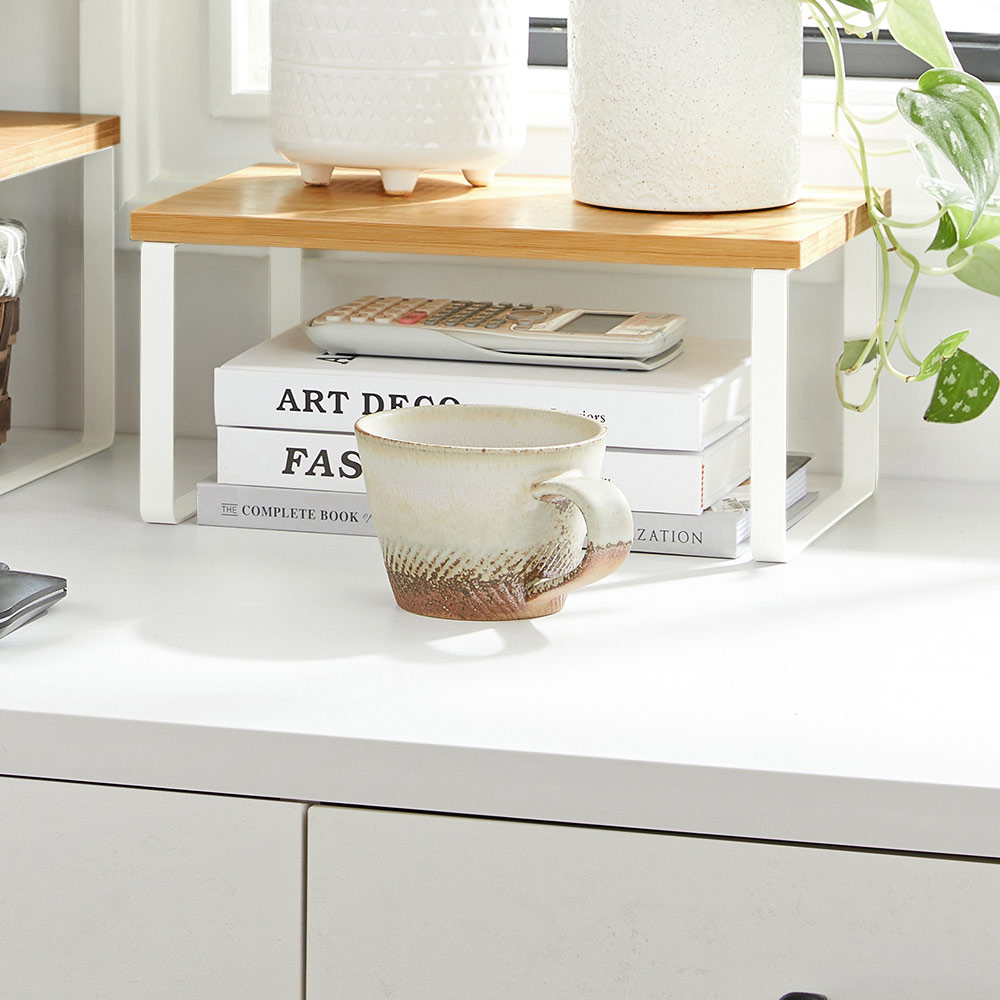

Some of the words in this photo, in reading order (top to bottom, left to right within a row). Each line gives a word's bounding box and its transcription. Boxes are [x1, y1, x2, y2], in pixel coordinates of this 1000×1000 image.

[276, 388, 350, 414] ART
[281, 446, 363, 479] FAS
[222, 504, 238, 514] THE
[241, 504, 316, 520] COMPLETE
[320, 508, 359, 523] BOOK
[635, 528, 704, 545] ZATION
